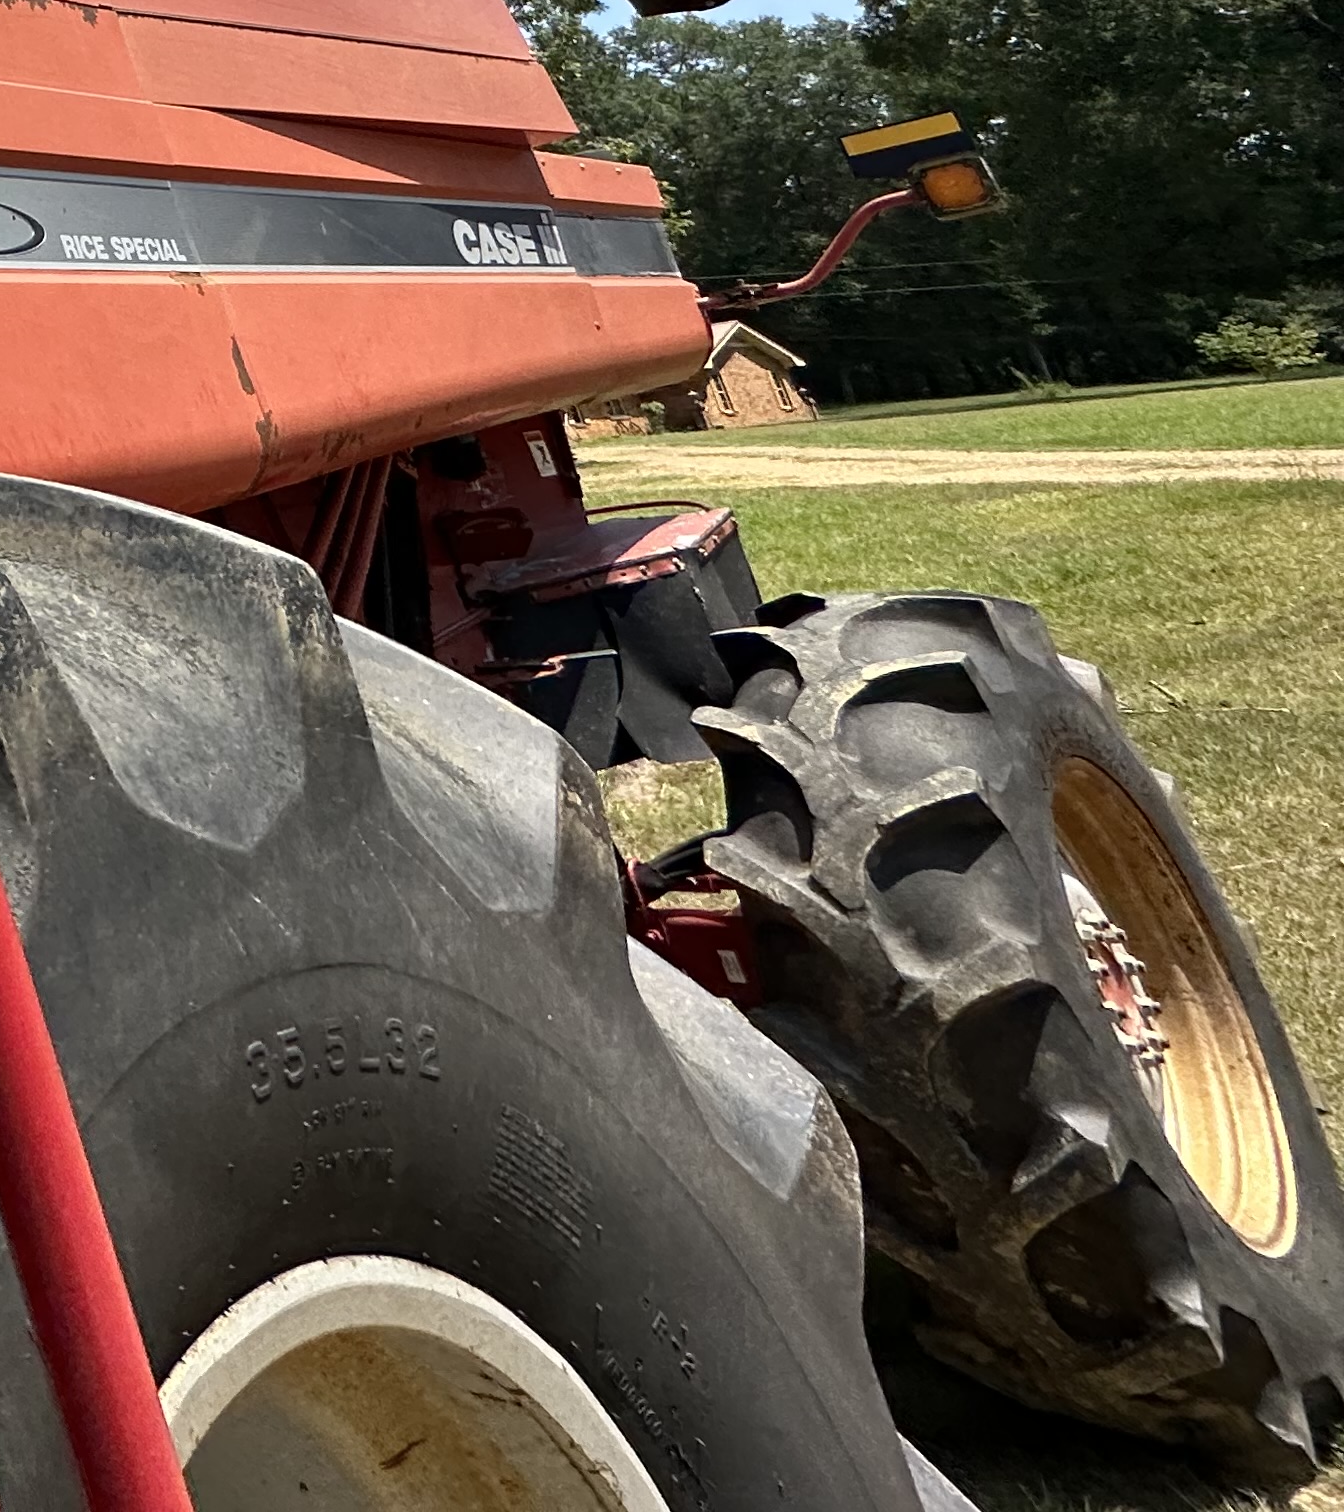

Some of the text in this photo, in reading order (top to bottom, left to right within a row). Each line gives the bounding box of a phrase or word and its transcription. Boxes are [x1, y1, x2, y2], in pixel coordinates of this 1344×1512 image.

[59, 234, 188, 262] RICE SPECIAL
[453, 219, 540, 265] CASE
